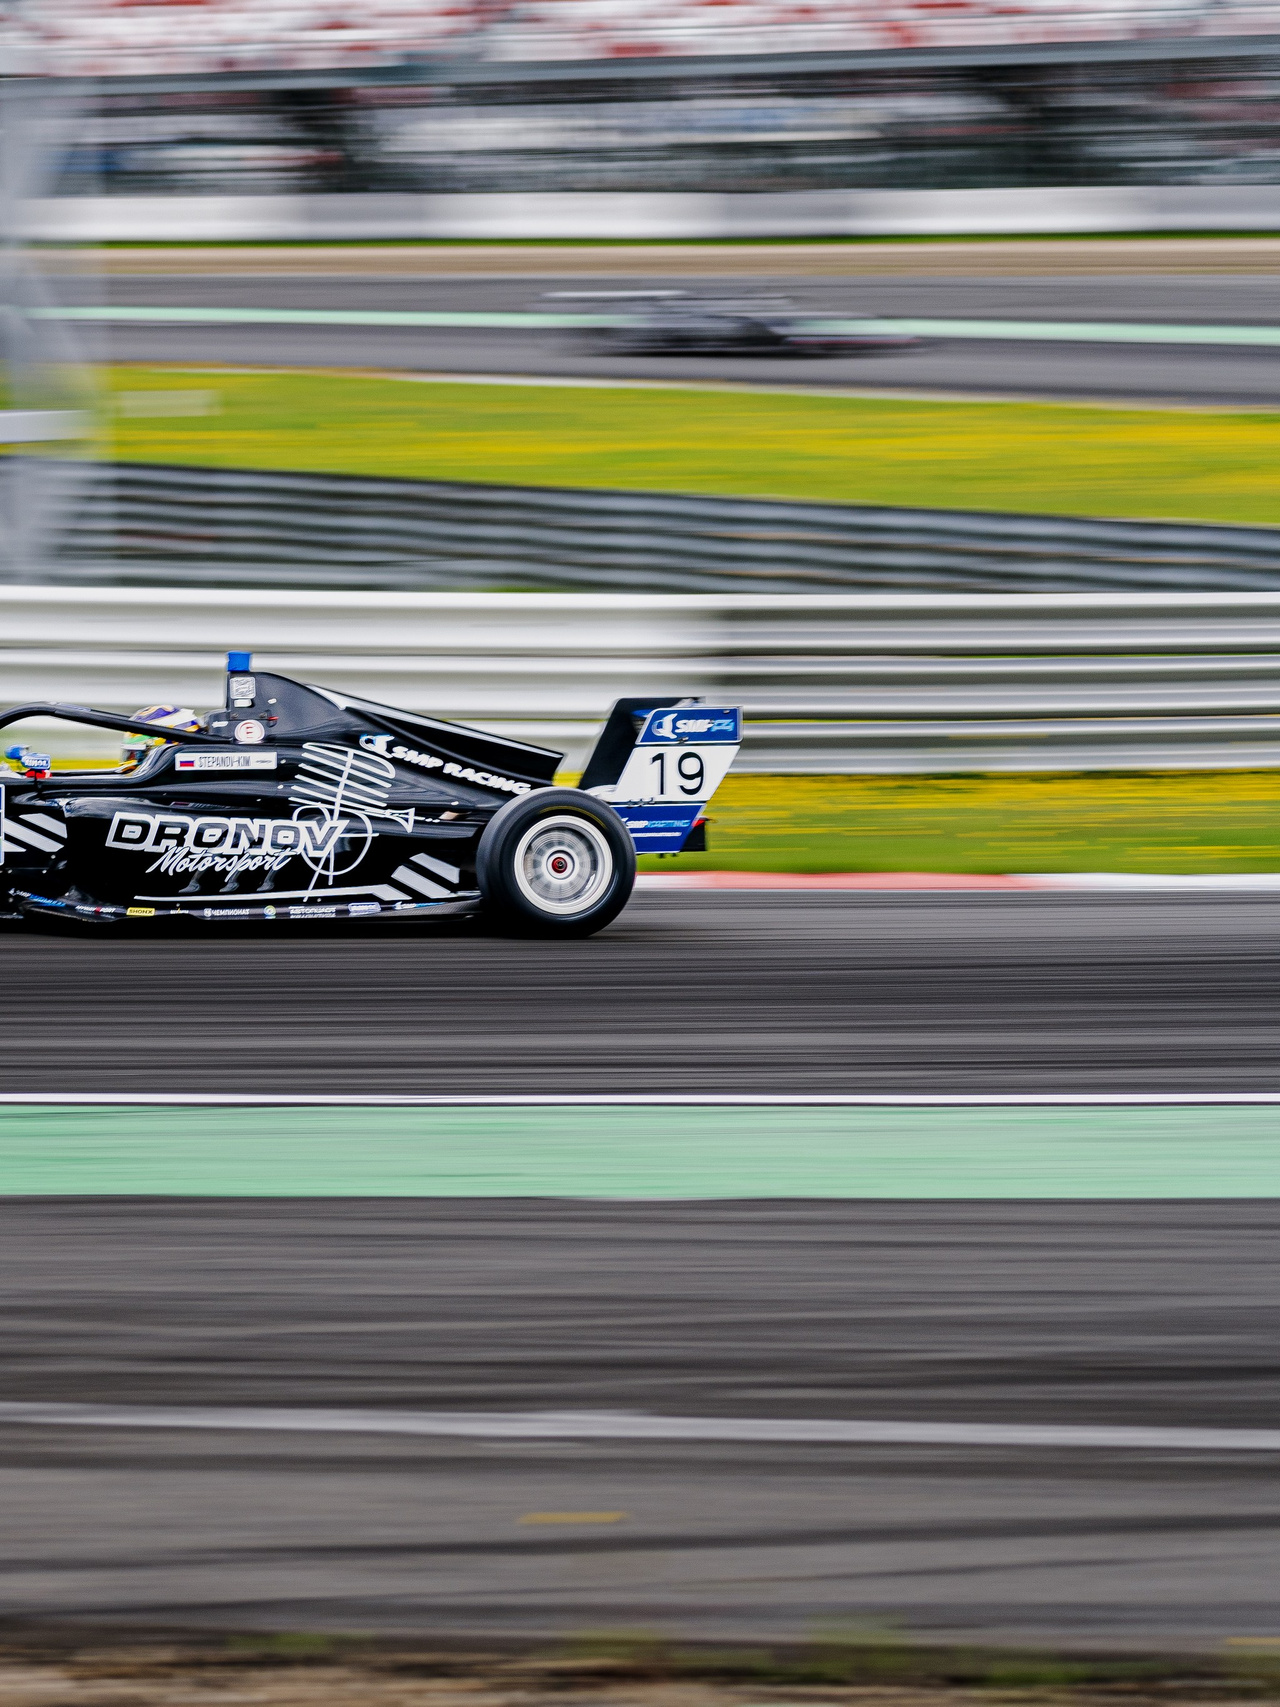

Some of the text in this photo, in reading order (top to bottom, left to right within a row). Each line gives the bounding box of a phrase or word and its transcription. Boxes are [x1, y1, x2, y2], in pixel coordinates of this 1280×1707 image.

[392, 746, 532, 795] SMP RACING
[650, 752, 705, 796] 19
[105, 811, 350, 857] DRONOV
[145, 846, 293, 882] Motorsport
